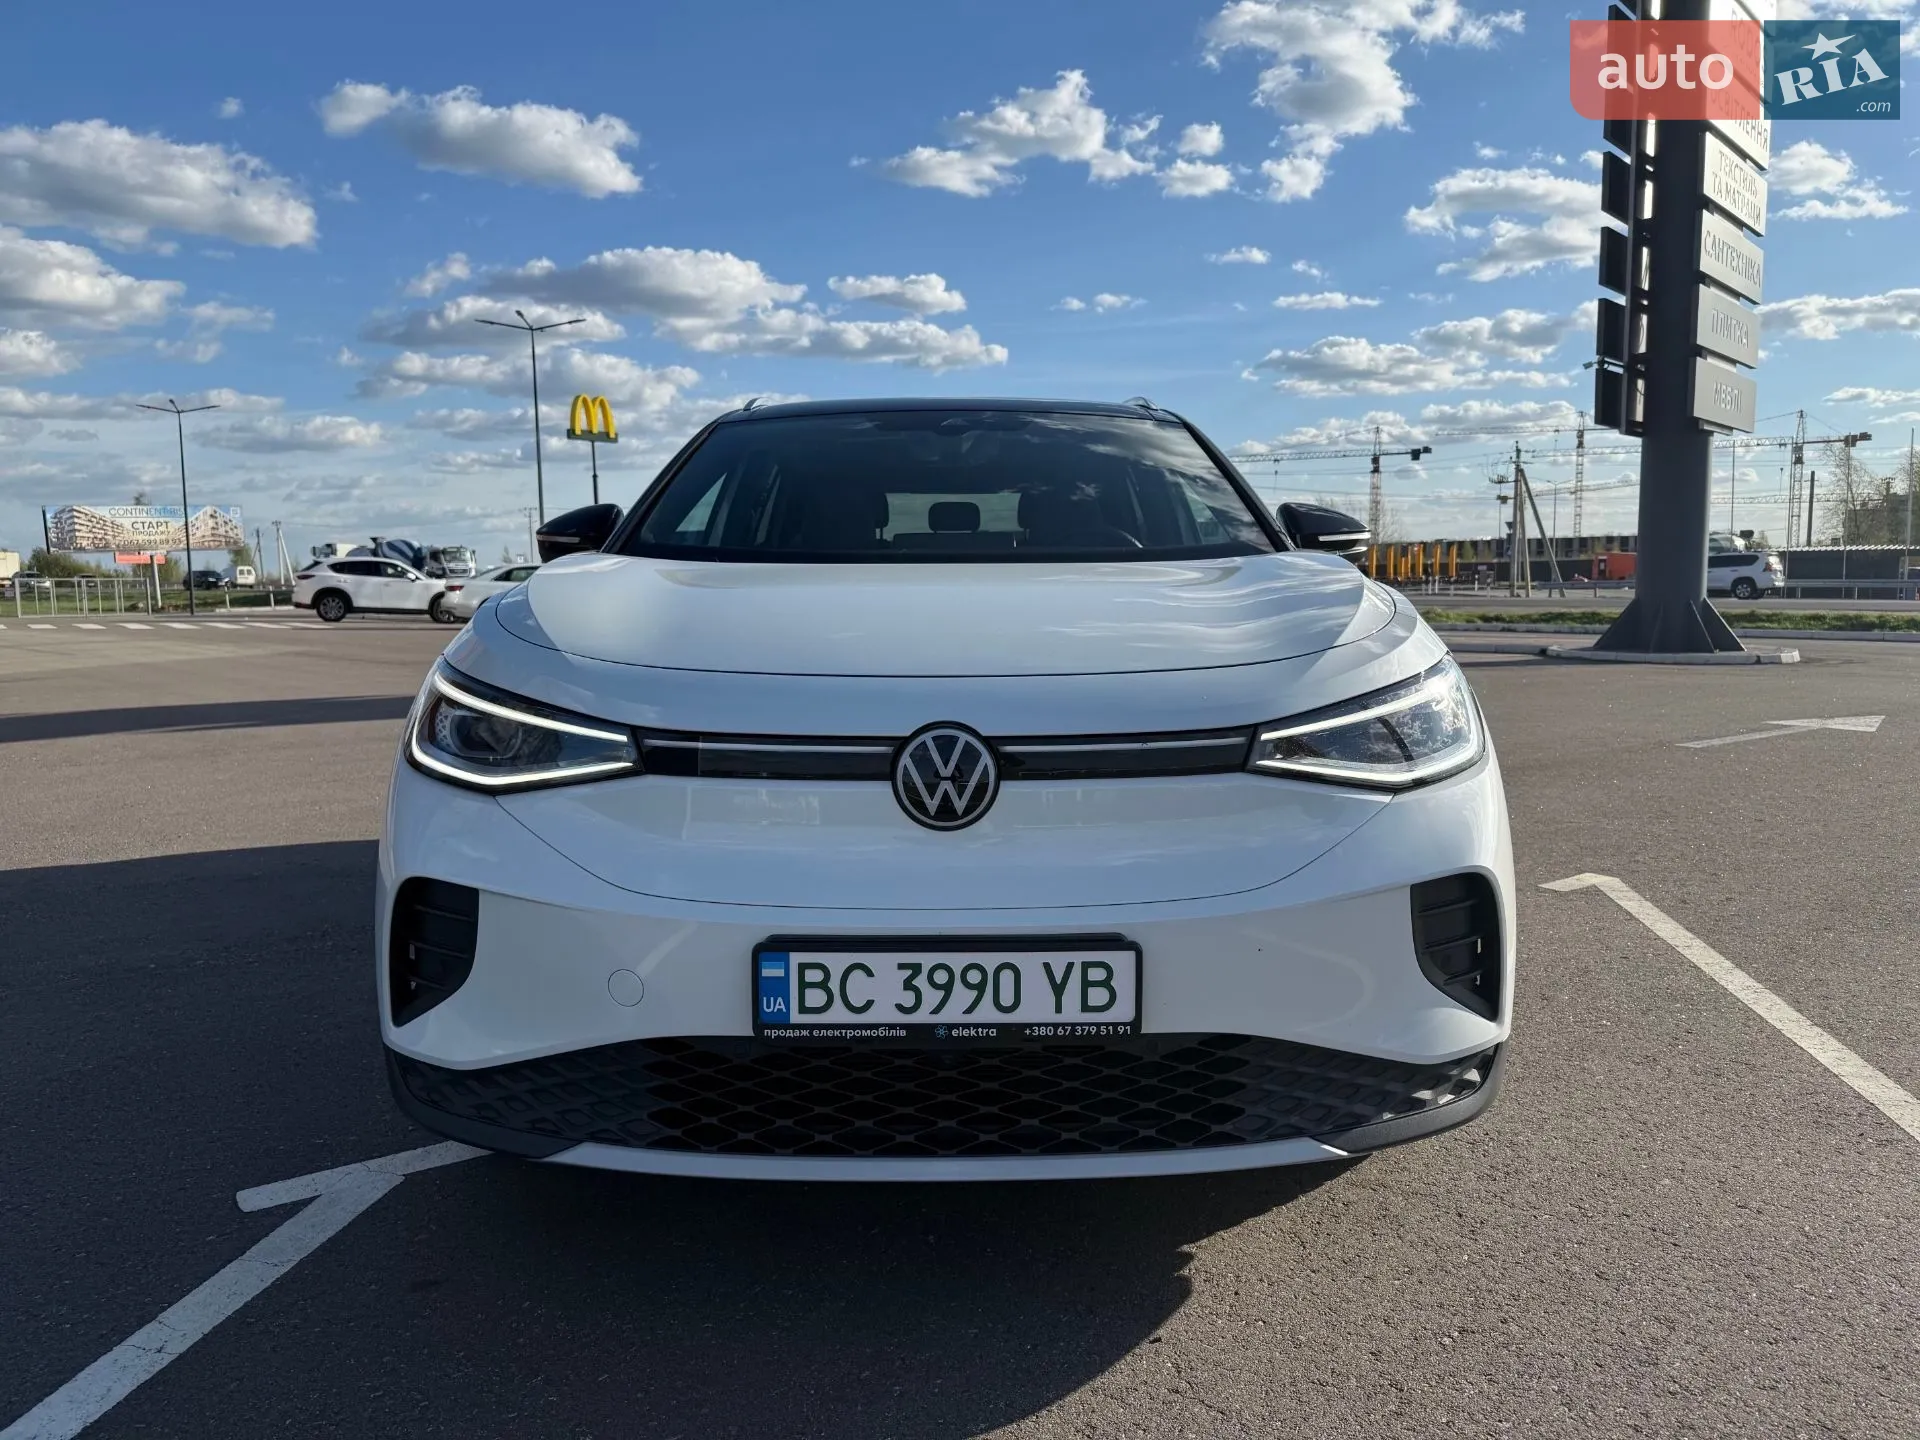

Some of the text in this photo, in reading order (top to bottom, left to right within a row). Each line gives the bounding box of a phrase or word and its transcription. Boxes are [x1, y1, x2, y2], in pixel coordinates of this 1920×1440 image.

[1719, 149, 1758, 199] ТЕКСТИЛЬ
[1712, 171, 1761, 227] ТА МАТРАЦИ
[1704, 230, 1761, 288] САНТЕХНІКА
[1711, 308, 1749, 349] ПЛИТКА
[1713, 381, 1742, 413] МЕБЛІ
[131, 520, 170, 530] СТАРТ
[899, 731, 991, 821] VW
[762, 996, 787, 1014] UA
[797, 960, 1117, 1015] BC 3990 YB
[764, 1026, 907, 1039] продаж електромобілів
[951, 1026, 997, 1037] elektra
[1024, 1025, 1131, 1036] +380 67 379 51 91
